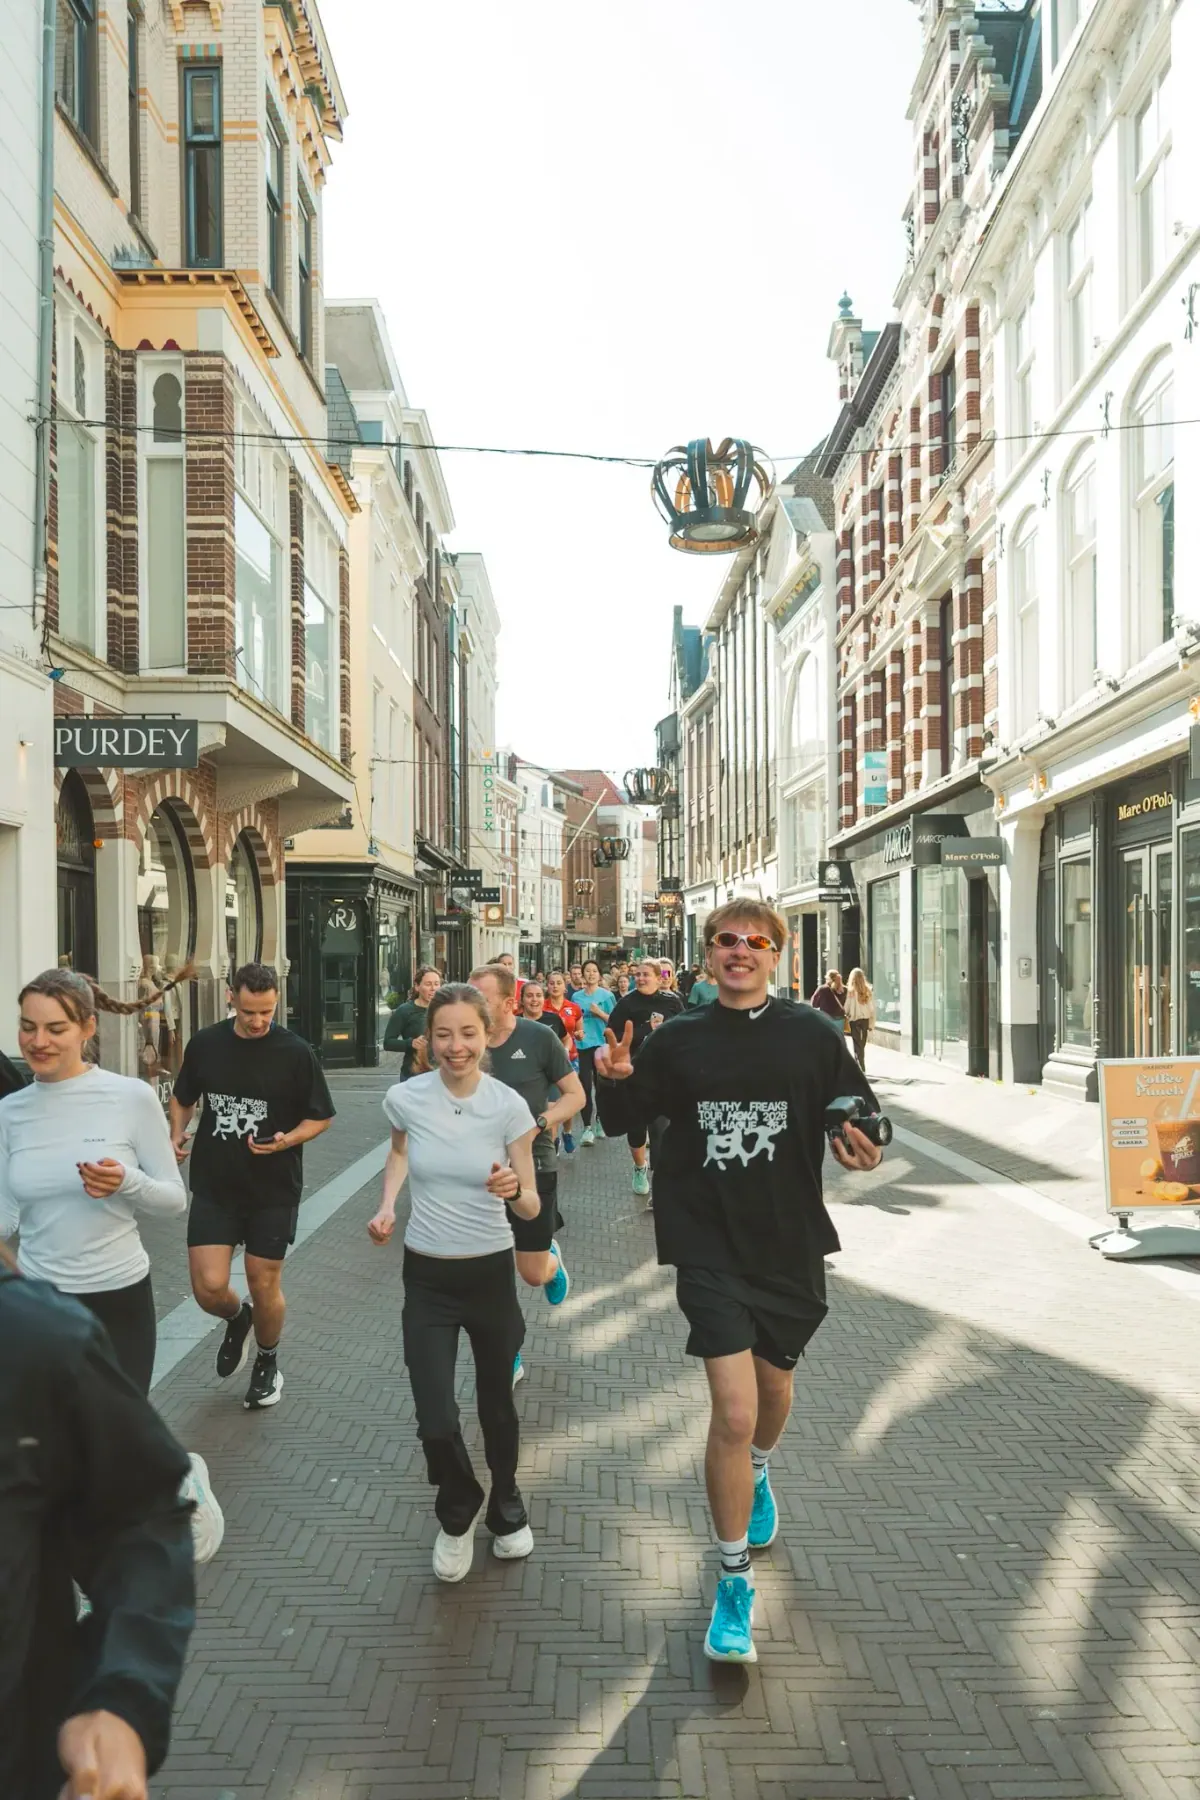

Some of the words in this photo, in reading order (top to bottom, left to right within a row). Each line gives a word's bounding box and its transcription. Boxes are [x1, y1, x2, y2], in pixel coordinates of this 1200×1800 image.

[55, 728, 190, 755] PURDEY
[484, 765, 493, 831] ROLEX
[1118, 804, 1141, 820] Marc
[1142, 791, 1173, 812] O'Polo
[971, 852, 1000, 860] O'Polo
[697, 1101, 741, 1112] HEALTHY
[749, 1101, 788, 1112] FREAKS
[698, 1110, 723, 1121] TOUR
[727, 1111, 758, 1121] HOKA
[763, 1111, 787, 1122] 2026
[698, 1120, 716, 1130] THE
